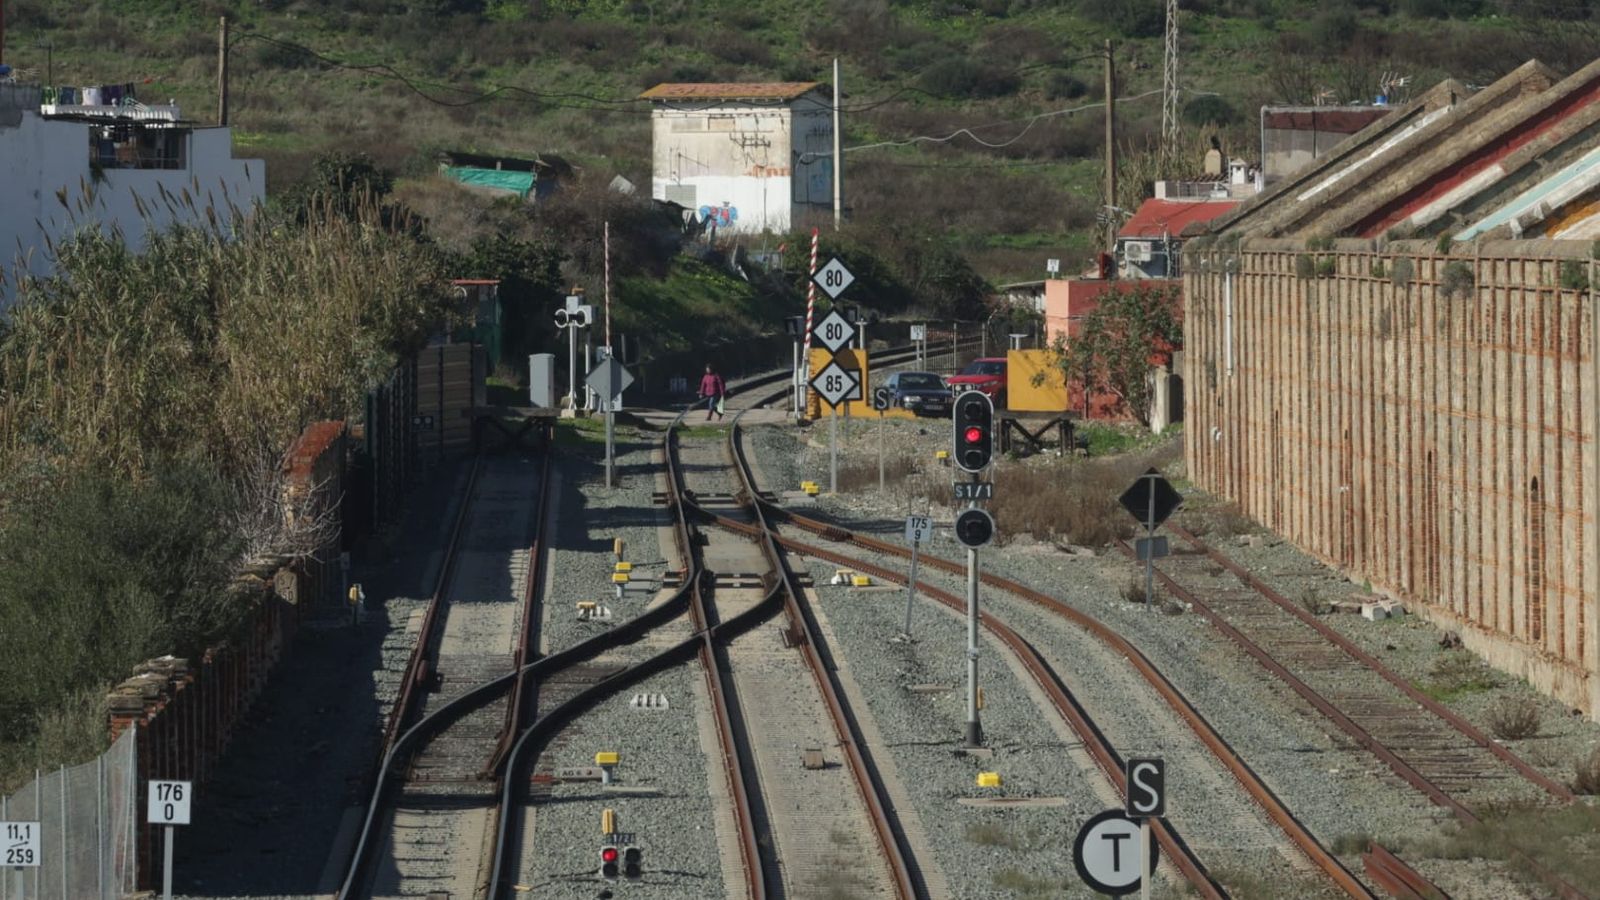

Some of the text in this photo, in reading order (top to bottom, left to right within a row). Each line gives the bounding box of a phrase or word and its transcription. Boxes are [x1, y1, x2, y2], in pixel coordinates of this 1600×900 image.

[826, 270, 842, 287] 80
[826, 323, 842, 340] 80
[826, 375, 842, 392] 85
[876, 388, 888, 409] S
[911, 517, 928, 529] 175
[914, 530, 921, 540] 9
[157, 783, 183, 801] 176
[1132, 762, 1160, 813] S
[164, 803, 174, 821] 0
[7, 824, 31, 841] 11,1
[6, 849, 34, 864] 259
[1101, 832, 1131, 872] T
